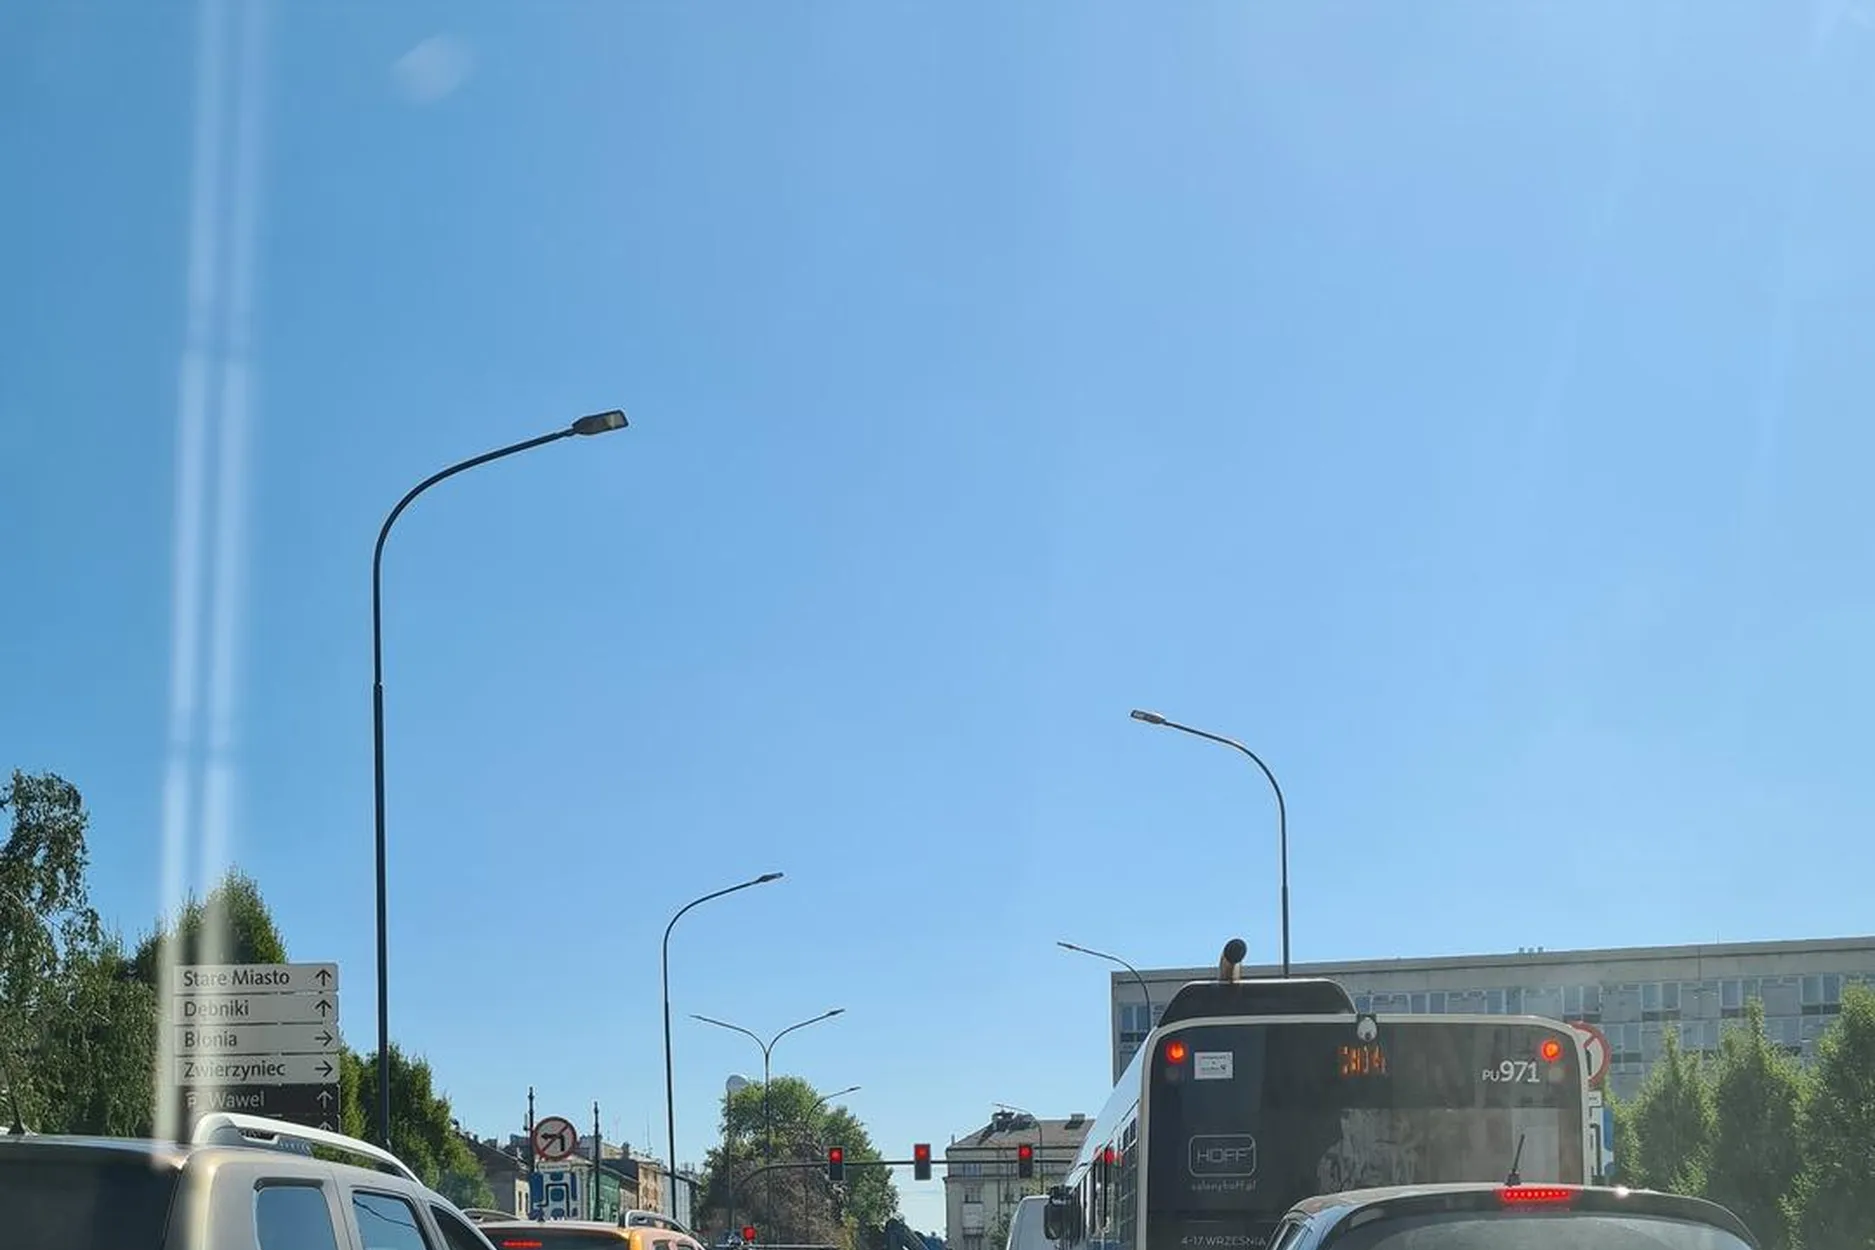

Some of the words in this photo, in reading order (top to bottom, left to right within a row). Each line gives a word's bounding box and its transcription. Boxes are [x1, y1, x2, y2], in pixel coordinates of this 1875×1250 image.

[183, 970, 227, 987] Stare
[231, 969, 290, 986] Miasto
[183, 1060, 286, 1080] Zwierzyniec
[208, 1091, 265, 1108] Wawel
